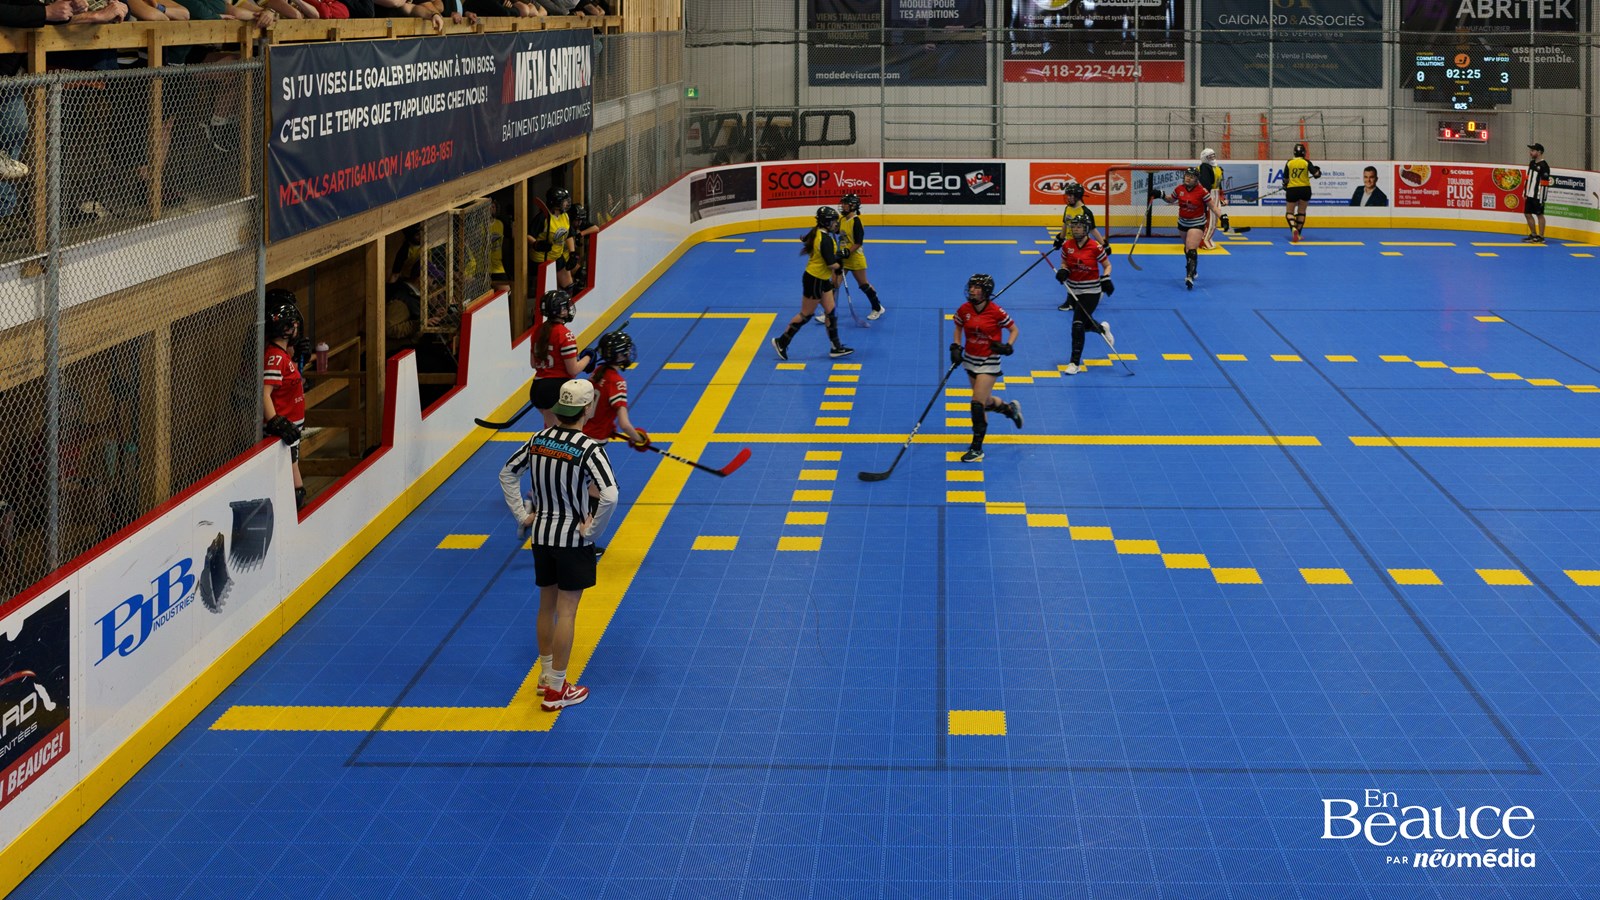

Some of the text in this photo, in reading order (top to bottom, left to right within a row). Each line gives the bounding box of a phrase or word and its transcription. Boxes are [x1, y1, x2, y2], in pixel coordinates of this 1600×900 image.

[900, 0, 955, 8] MODULE POUR
[816, 13, 880, 21] VIENS TRAVAILLER
[900, 10, 959, 18] TES AMBITIONS
[1290, 16, 1298, 24] &
[1298, 13, 1365, 26] ASSOCIÉS
[283, 53, 496, 101] SI TU VISES LE GOALER EN PENSANT À TON BOSS,
[514, 42, 548, 102] MÉTAL
[1416, 71, 1424, 82] 0
[1446, 69, 1480, 78] 02:25
[1500, 72, 1508, 83] 3
[280, 115, 317, 143] C'EST
[320, 112, 333, 137] LE
[335, 105, 369, 133] TEMPS
[370, 102, 392, 126] QUE
[393, 93, 446, 121] T'APPLIQUES
[447, 88, 465, 111] CHEZ
[502, 116, 539, 142] BÂTIMENTS
[889, 170, 961, 190] ubéo
[1291, 168, 1305, 178] 87
[279, 154, 398, 208] METALSARTIGAN.COM
[768, 170, 873, 191] SCOOP Vision
[1446, 186, 1474, 200] PLUS
[1456, 198, 1474, 208] GOÛT
[268, 356, 282, 366] 27
[546, 440, 583, 458] Hockey
[94, 557, 196, 667] PJB
[153, 592, 195, 632] INDUSTRIES
